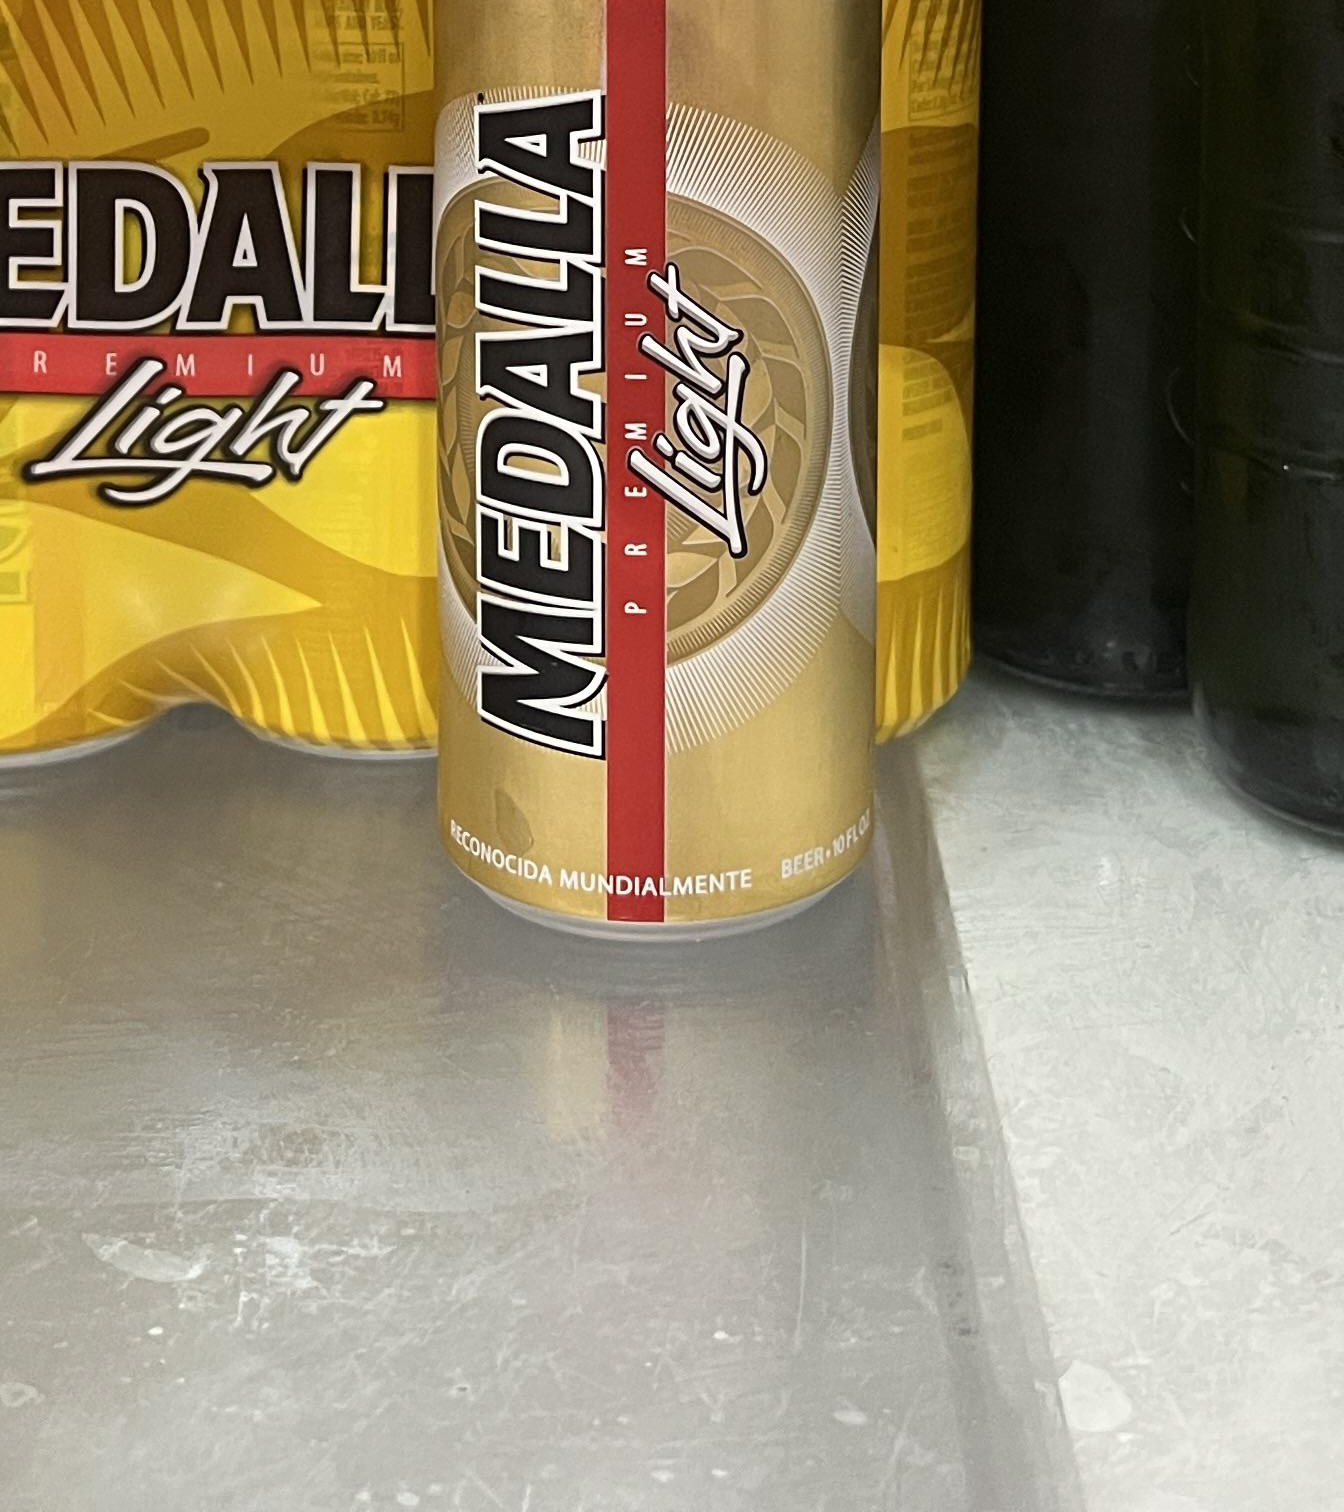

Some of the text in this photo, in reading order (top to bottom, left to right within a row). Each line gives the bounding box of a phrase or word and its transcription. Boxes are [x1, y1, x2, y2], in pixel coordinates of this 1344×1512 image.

[22, 357, 386, 508] Light
[473, 90, 607, 759] MEDALLA
[623, 246, 650, 616] PREMIUM
[627, 260, 769, 560] Light
[450, 818, 554, 886] RECONOCIDA
[558, 868, 754, 897] MUNDIALMENTE
